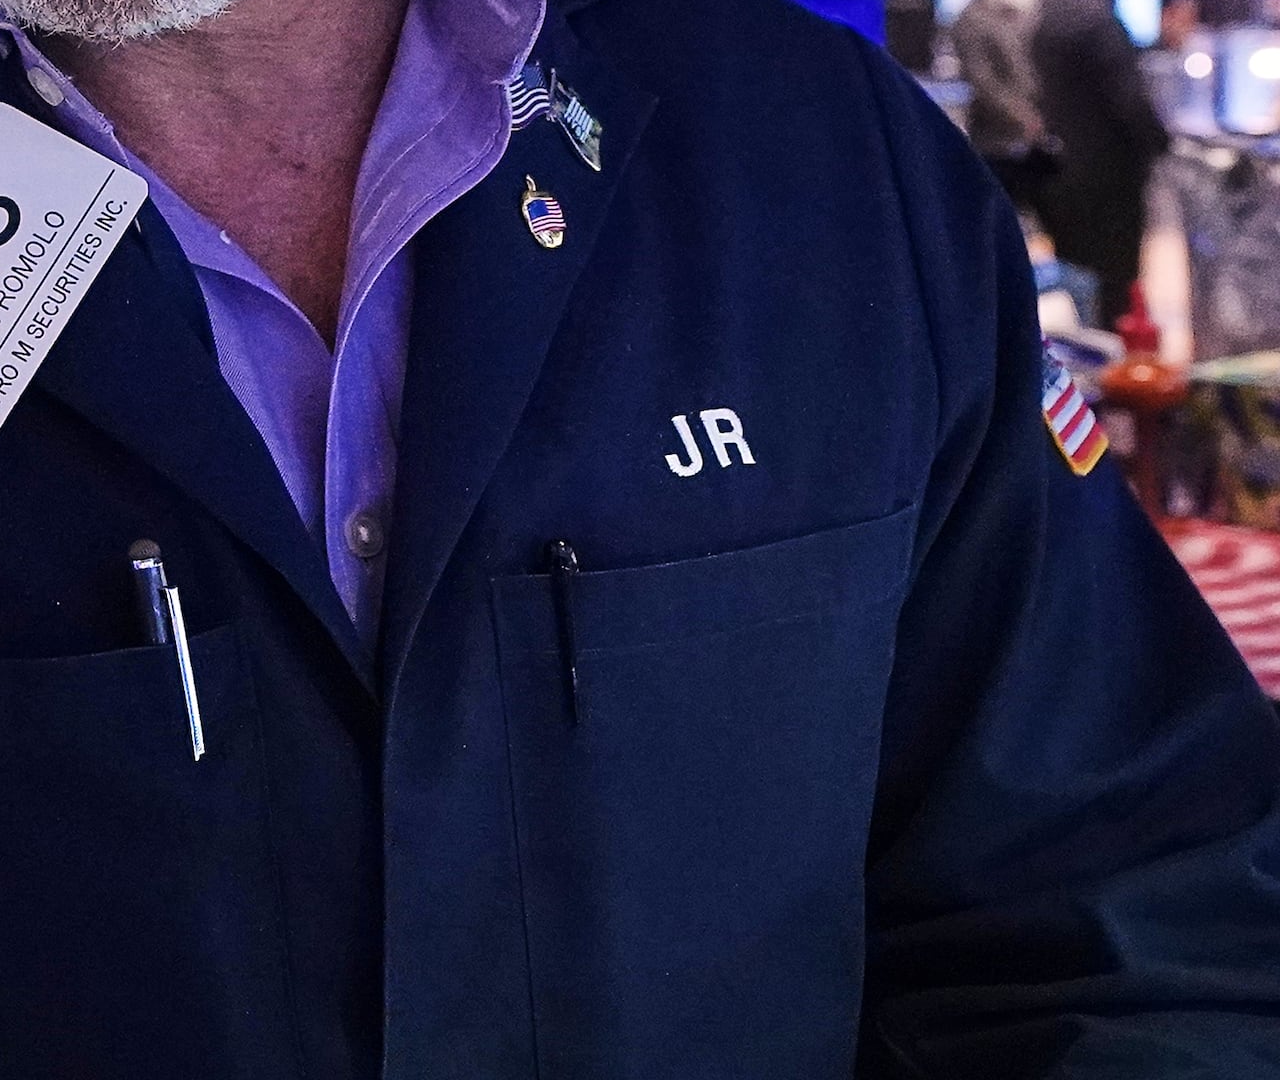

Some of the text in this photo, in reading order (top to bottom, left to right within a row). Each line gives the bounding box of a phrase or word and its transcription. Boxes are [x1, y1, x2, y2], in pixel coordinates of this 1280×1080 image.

[11, 340, 35, 363] M
[26, 232, 102, 339] SECURITIES
[93, 198, 128, 233] INC.
[664, 407, 757, 477] JR
